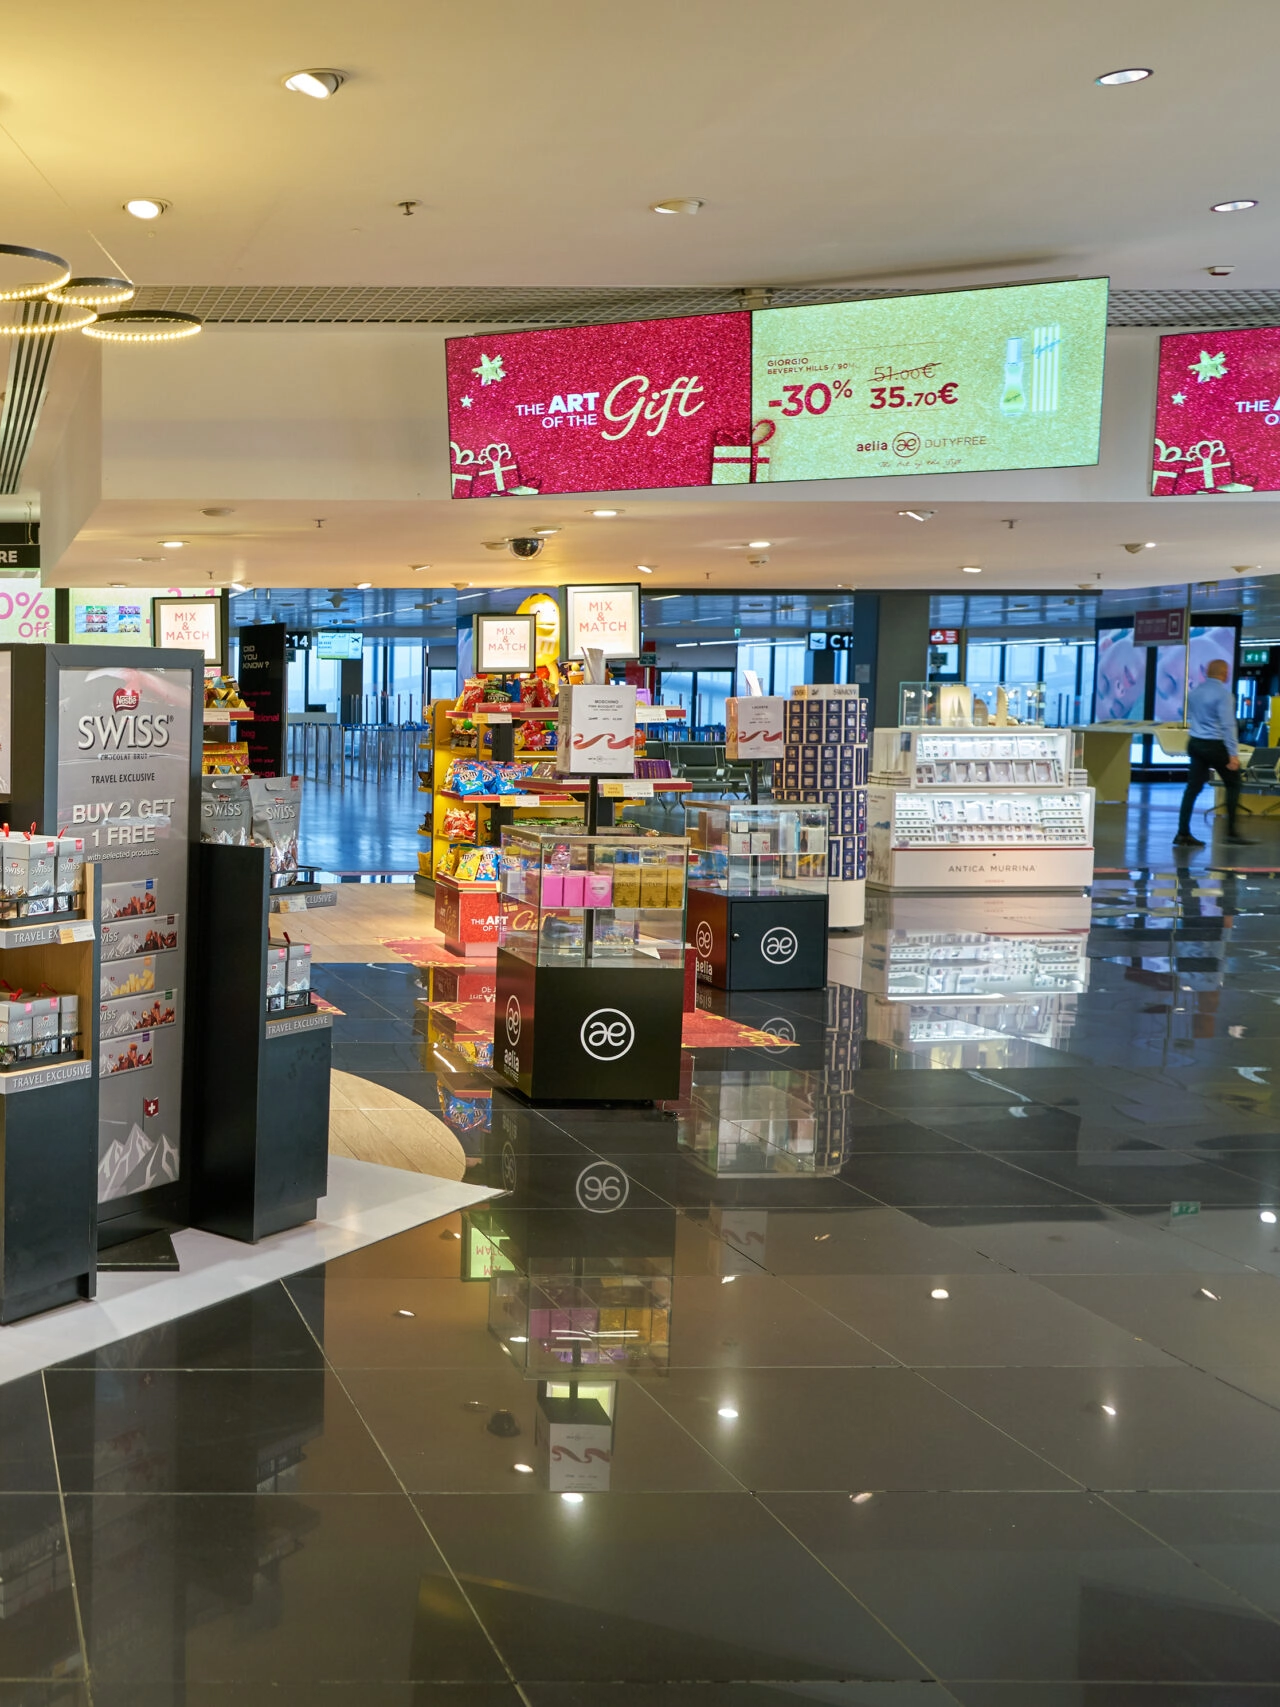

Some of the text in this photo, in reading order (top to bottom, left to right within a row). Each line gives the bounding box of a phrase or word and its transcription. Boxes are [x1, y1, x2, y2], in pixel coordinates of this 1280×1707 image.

[767, 358, 809, 367] GIORGIO
[767, 364, 828, 375] BEVERLY HILLS
[768, 379, 853, 417] -30%
[870, 382, 959, 410] 35.70€
[515, 392, 600, 416] THE ART
[601, 375, 704, 440] Gift
[1235, 400, 1270, 413] THE
[542, 414, 597, 429] OF THE
[856, 441, 888, 452] aelia
[925, 436, 987, 448] DUTYFREE
[588, 601, 613, 612] MIX
[175, 612, 196, 622] MIX
[596, 612, 606, 622] &
[18, 621, 51, 638] Off
[182, 622, 189, 630] &
[496, 627, 515, 636] MIX
[579, 621, 627, 633] MATCH
[166, 631, 209, 641] MATCH
[488, 642, 527, 651] MATCH
[242, 653, 257, 661] YOU
[78, 714, 171, 750] SWISS
[134, 752, 148, 760] BRUT
[91, 772, 155, 784] TRAVEL EXCLUSIVE
[73, 799, 175, 824] BUY 2 GET
[204, 803, 242, 818] SWISS
[266, 805, 296, 820] SWISS
[91, 825, 155, 847] 1 FREE
[87, 848, 159, 861] with selected products
[4, 865, 25, 876] SWISS
[31, 864, 52, 875] SWISS
[60, 862, 80, 872] SWISS
[948, 865, 1036, 873] ANTICA MURRINA
[305, 894, 333, 905] CLUSIVE
[486, 916, 508, 925] ART
[14, 930, 46, 943] TRAVEL
[268, 1015, 328, 1035] TRAVEL EXCLUSIVE
[12, 1065, 91, 1089] TRAVEL EXCLUSIVE
